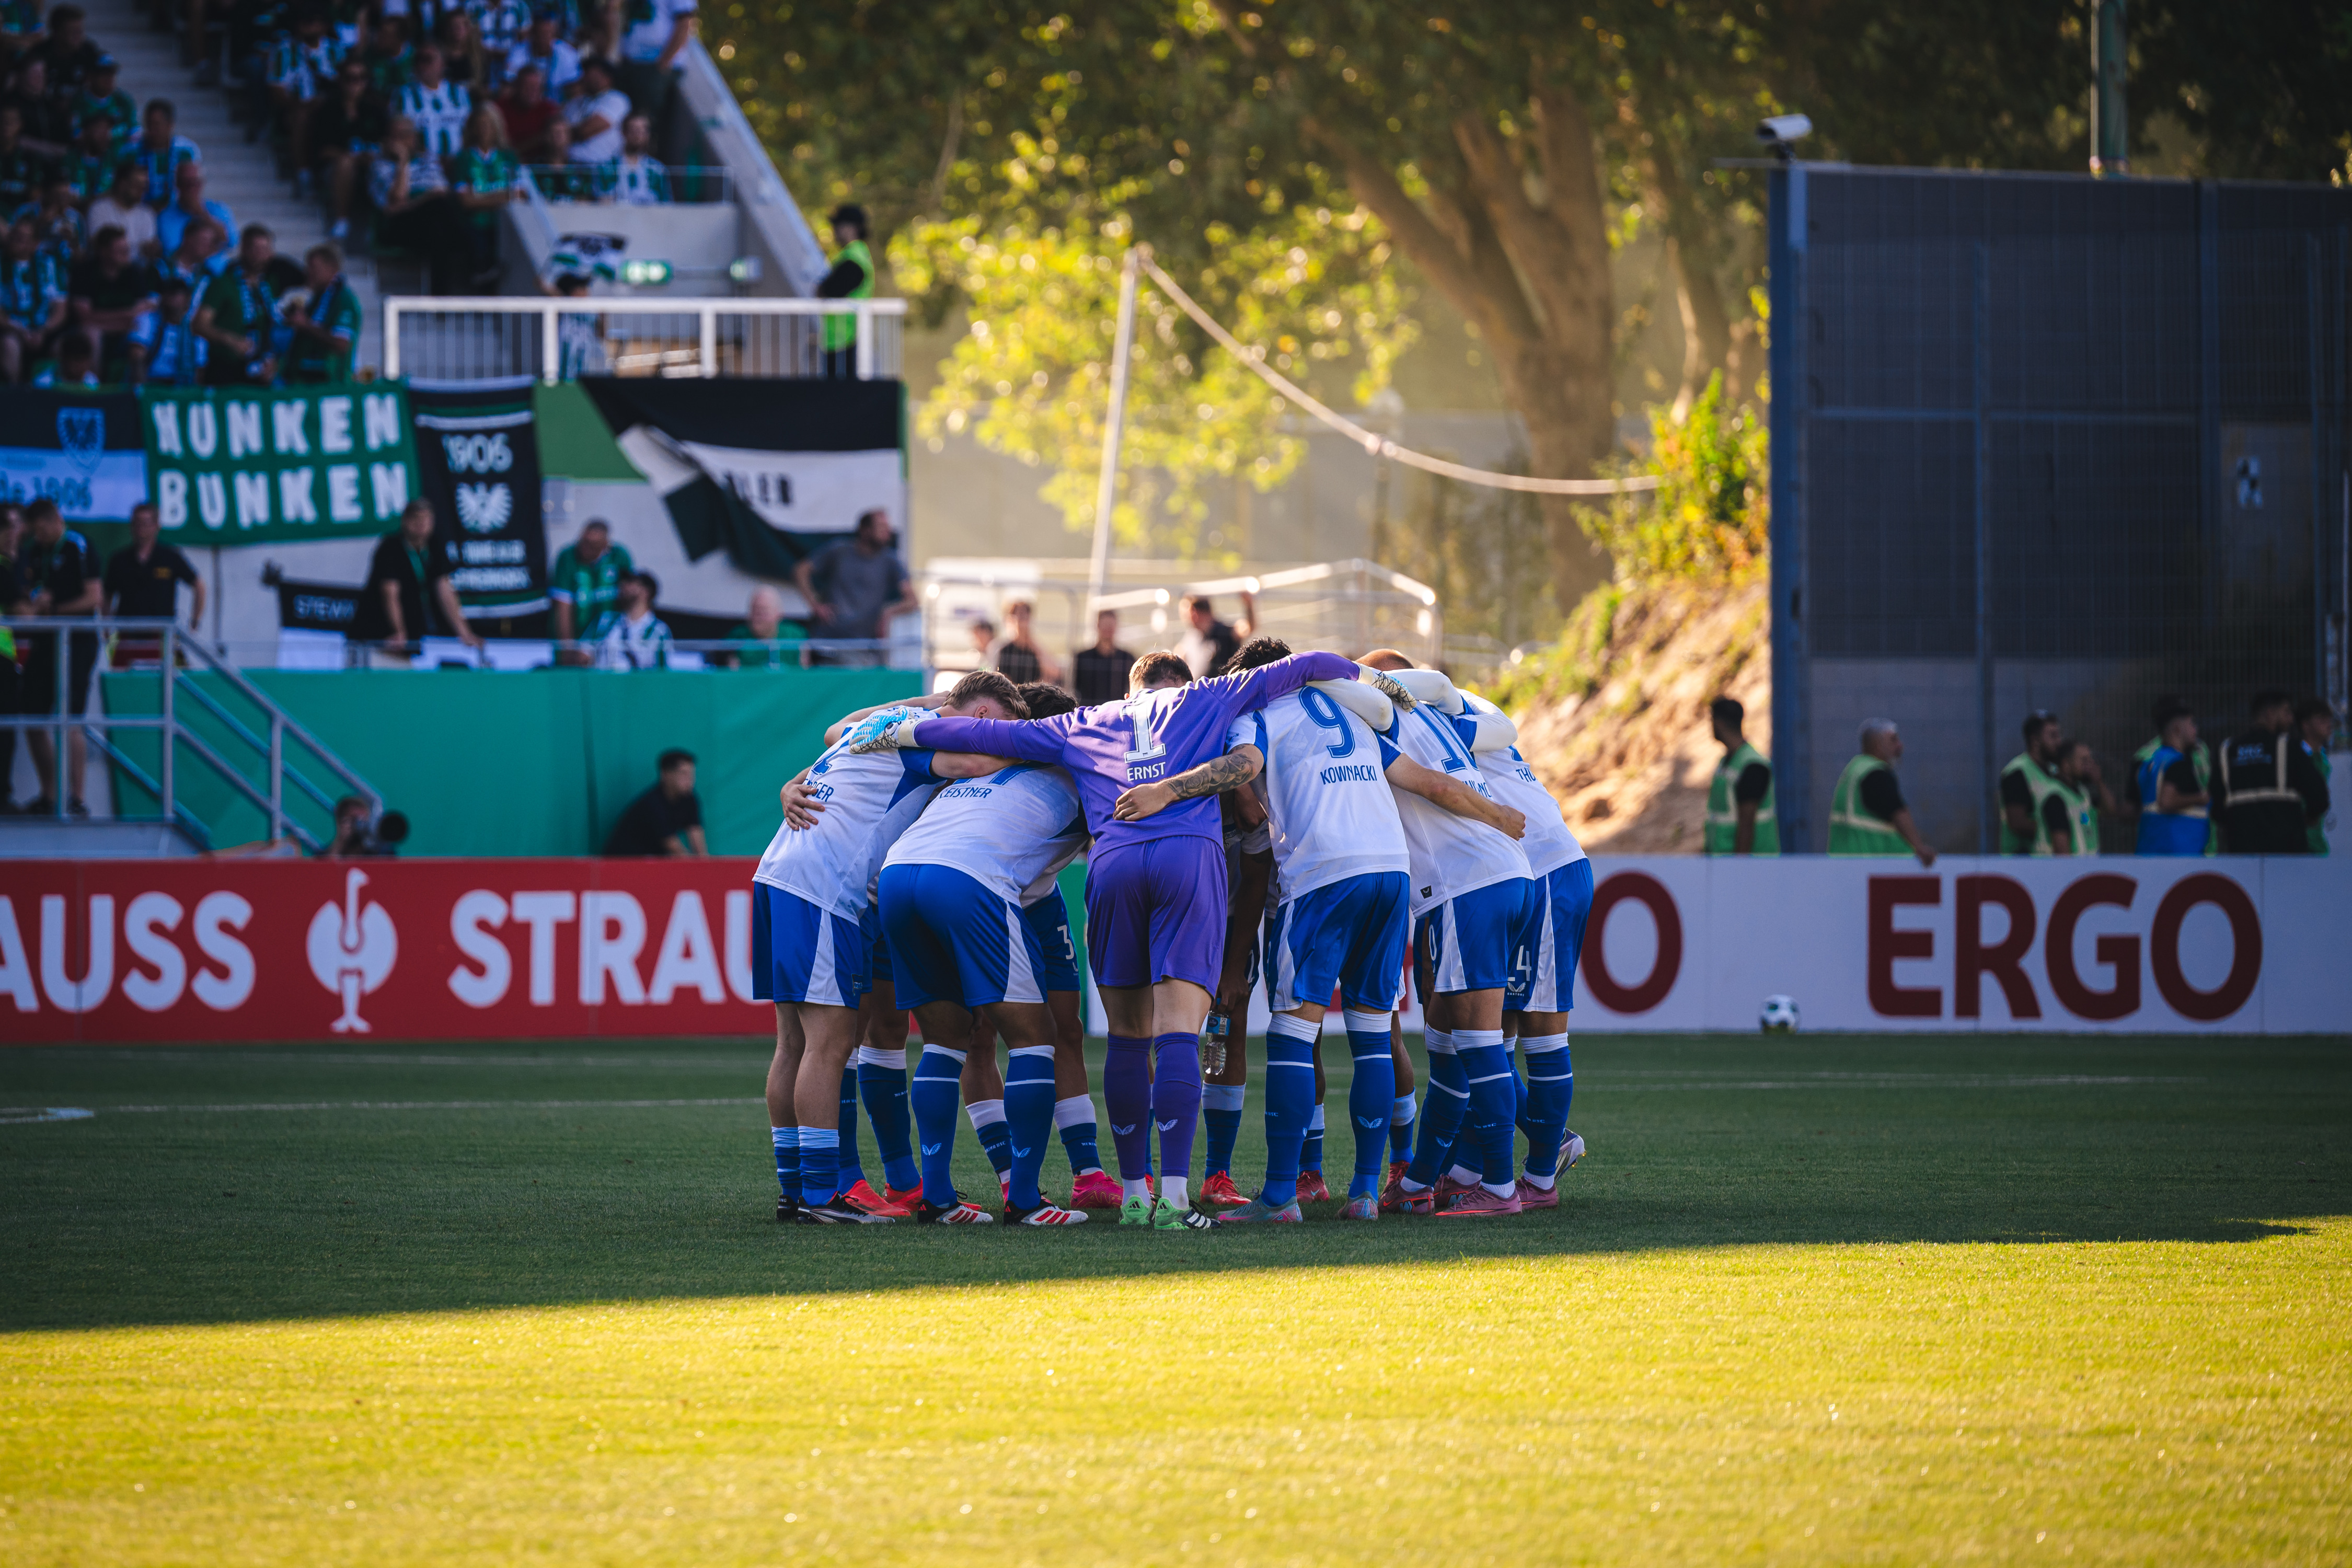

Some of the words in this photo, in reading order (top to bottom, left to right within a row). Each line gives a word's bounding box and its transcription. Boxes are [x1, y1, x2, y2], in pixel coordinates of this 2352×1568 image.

[441, 432, 513, 474] 1906
[158, 462, 408, 531] BUNKEN
[1121, 706, 1166, 763] 1
[1298, 685, 1355, 758] 9
[1126, 762, 1166, 782] ERNST
[1320, 765, 1377, 785] KOWNACKI
[1866, 871, 2263, 1022] ERGO
